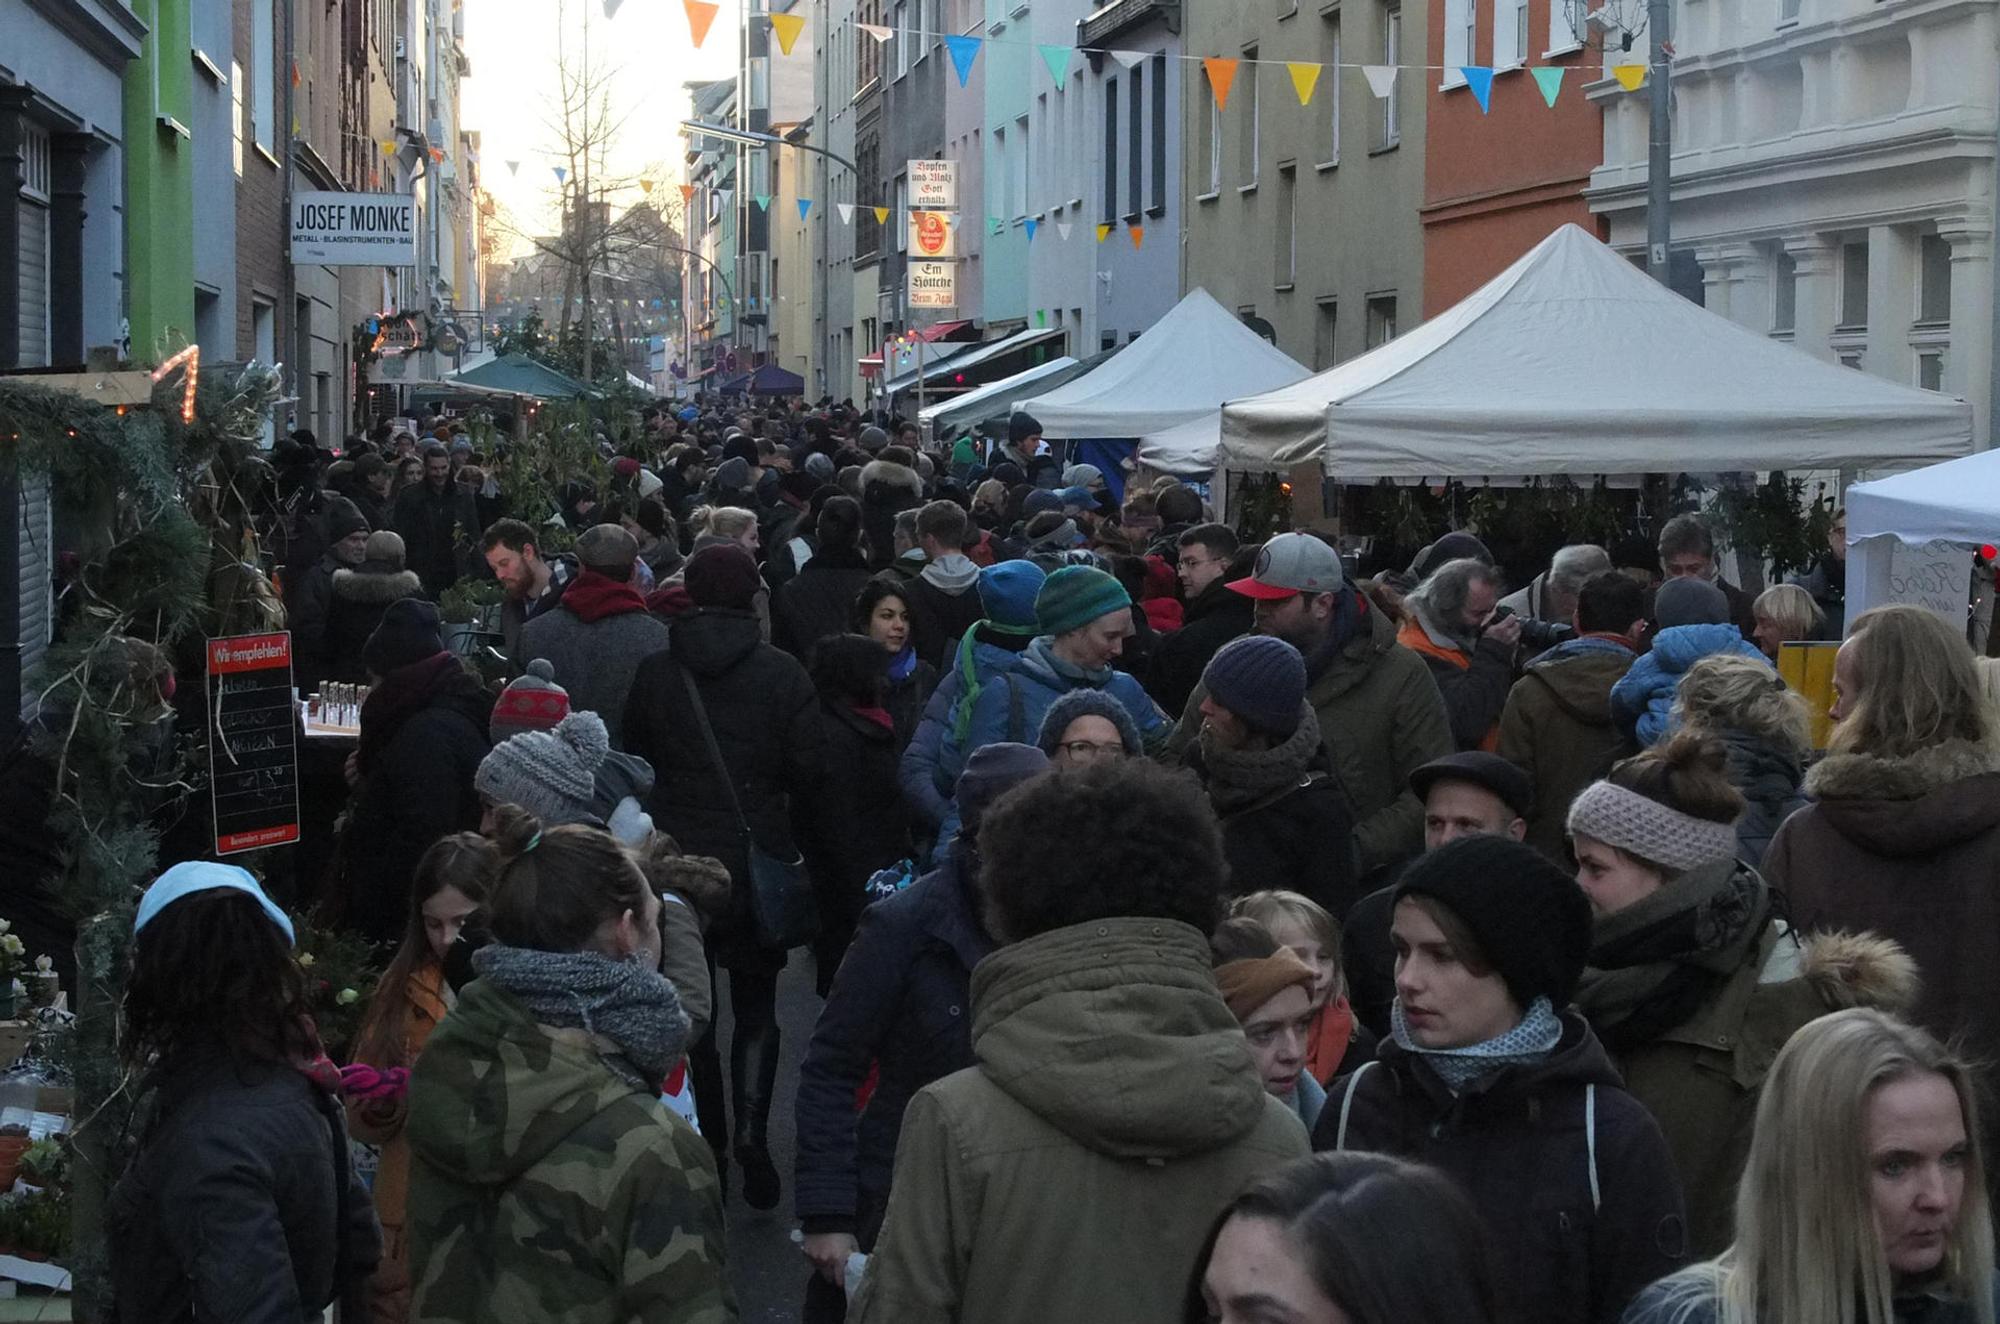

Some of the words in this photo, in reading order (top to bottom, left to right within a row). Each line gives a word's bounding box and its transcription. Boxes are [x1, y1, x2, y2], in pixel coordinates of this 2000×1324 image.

[912, 173, 927, 182] und
[921, 184, 943, 193] Gott
[296, 204, 346, 230] JOSEF
[350, 205, 410, 232] MONKE
[292, 235, 319, 243] METALL
[323, 235, 395, 245] BLASINSTRUMENTEN
[399, 237, 413, 245] BAU
[921, 263, 942, 275] Em
[214, 646, 231, 663] Wir
[232, 641, 287, 665] empfehlen!
